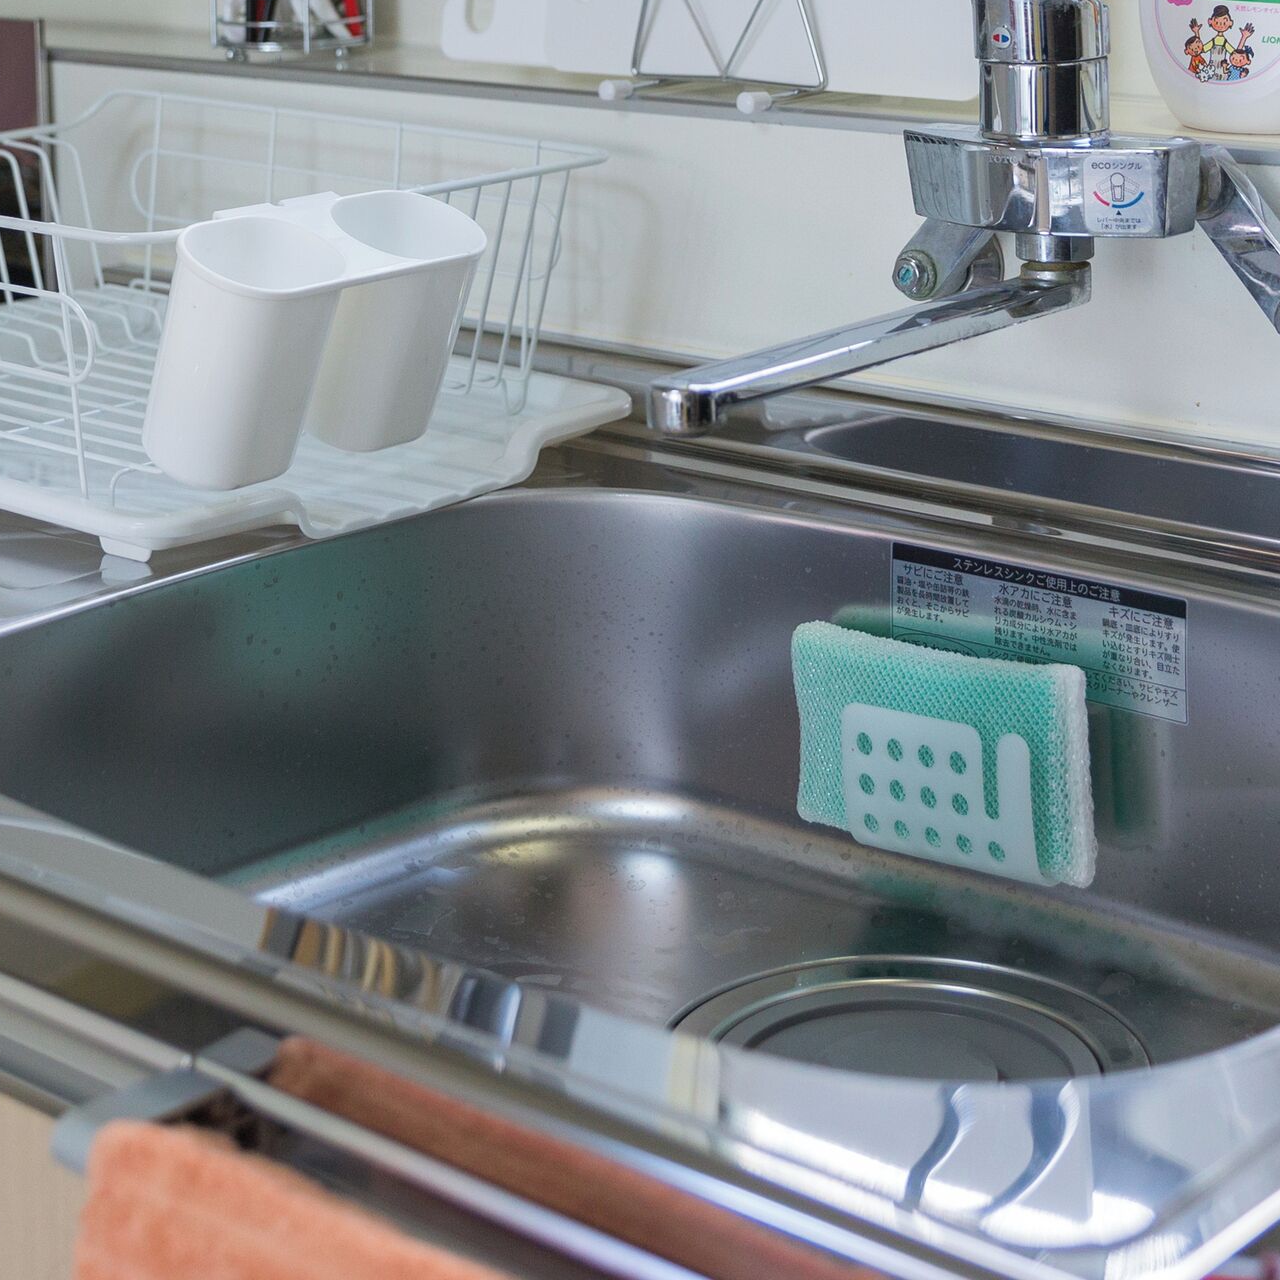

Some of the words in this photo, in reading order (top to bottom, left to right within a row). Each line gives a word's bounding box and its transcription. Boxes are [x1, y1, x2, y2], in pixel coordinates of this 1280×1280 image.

[903, 564, 964, 585] サビにご注意
[953, 557, 1121, 602] ステンレスシンクご使用上のご注意
[998, 583, 1073, 608] 水アカにご注意
[896, 606, 944, 624] が発生します。
[1109, 606, 1174, 630] キズにご注意
[994, 636, 1051, 657] 除去できません。
[1102, 629, 1180, 654] キズが発生します。使
[1102, 640, 1180, 665] い込むとすりキズ同士
[1102, 650, 1180, 676] が重なり合い、目立た
[1103, 661, 1153, 680] なくなります。
